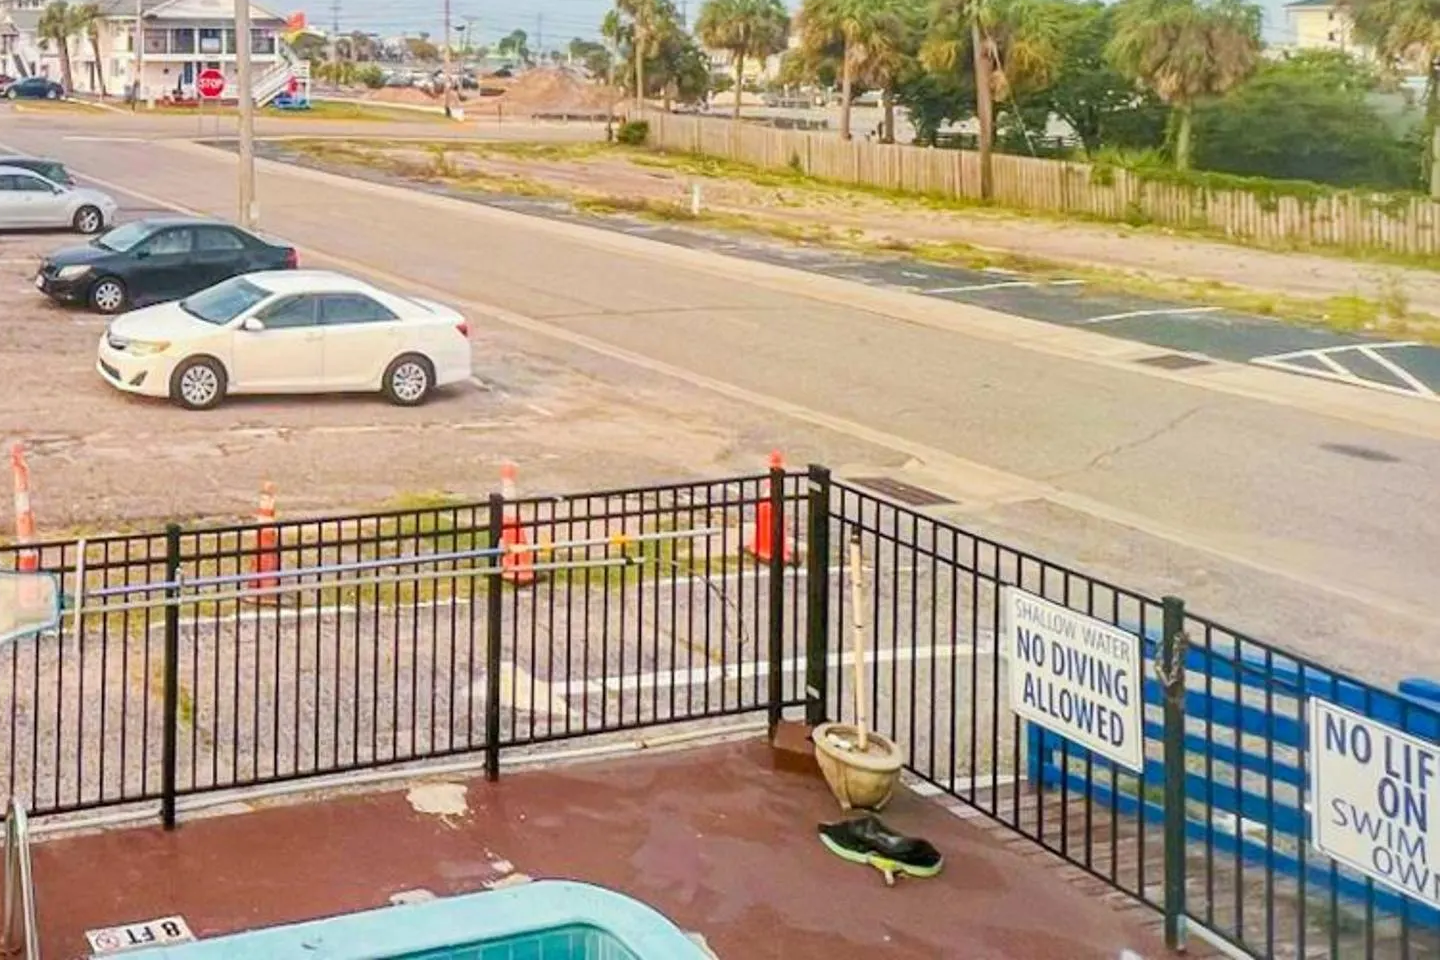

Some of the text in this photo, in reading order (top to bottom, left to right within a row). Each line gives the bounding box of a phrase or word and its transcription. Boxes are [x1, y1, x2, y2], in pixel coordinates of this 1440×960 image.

[1015, 598, 1130, 662] SHALLOW WATER
[1017, 626, 1128, 706] NO DIVING
[1023, 672, 1125, 747] ALLOWED
[1325, 712, 1440, 789] NO LIF
[1331, 797, 1426, 865] SWIM
[1378, 777, 1428, 833] ON
[126, 921, 180, 945] 8 FT
